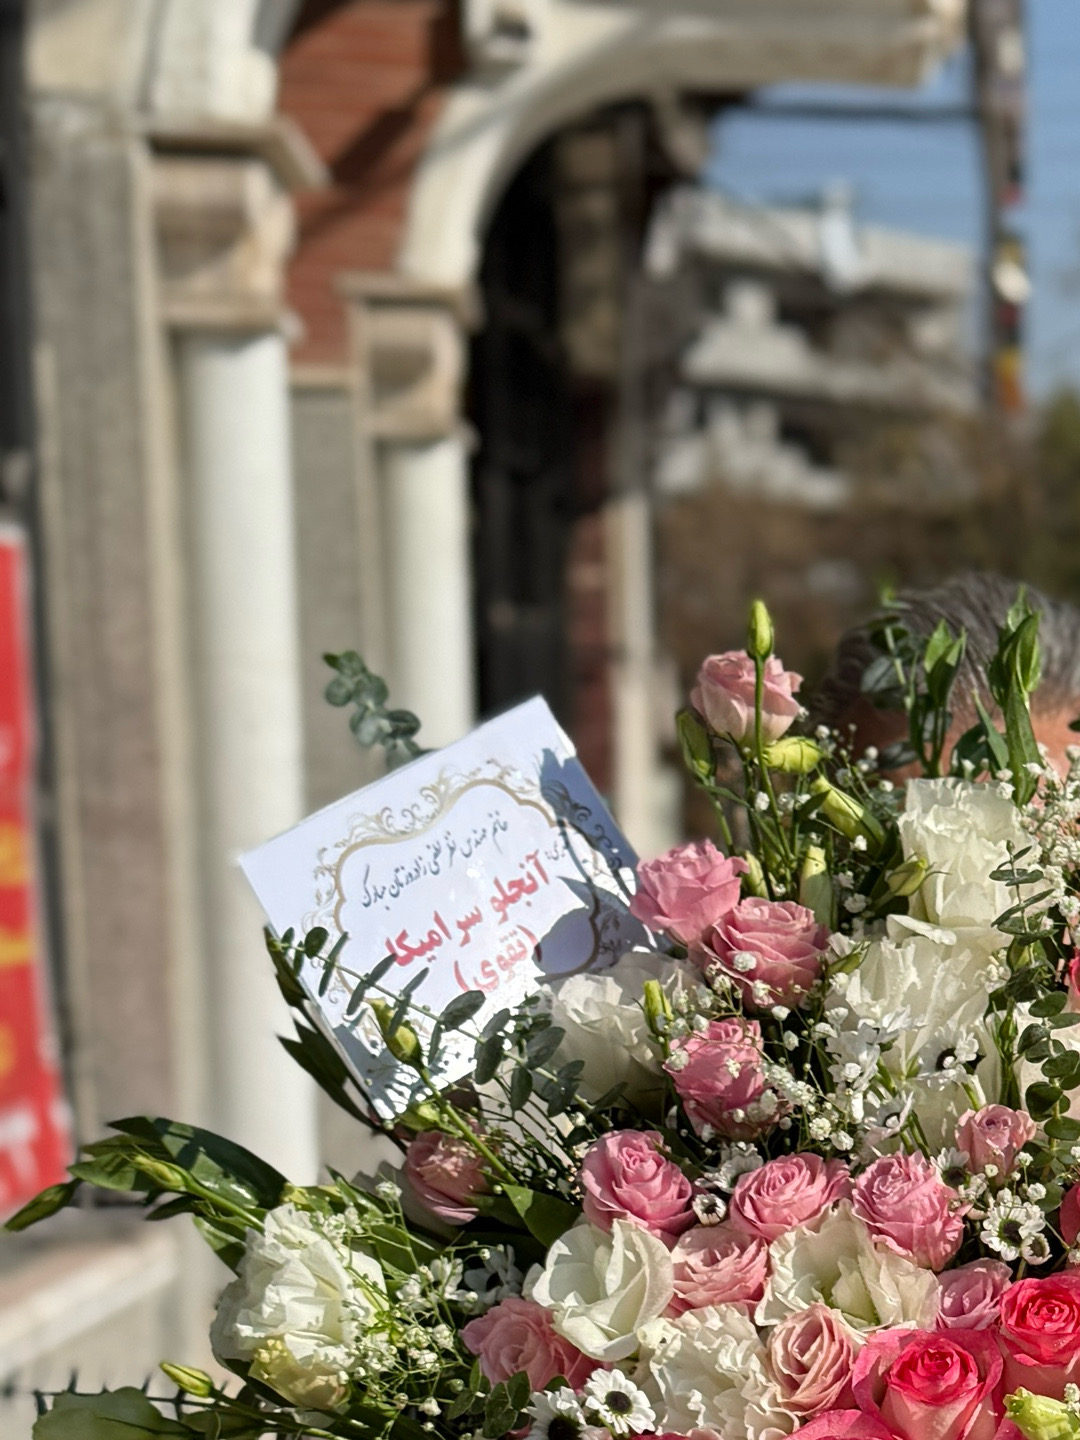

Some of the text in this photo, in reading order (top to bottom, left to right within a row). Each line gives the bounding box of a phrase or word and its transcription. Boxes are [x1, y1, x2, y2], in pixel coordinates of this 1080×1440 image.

[459, 828, 487, 858] مهندس
[488, 811, 508, 853] خانم
[361, 863, 391, 911] مبارک
[489, 849, 549, 925] آنجلو
